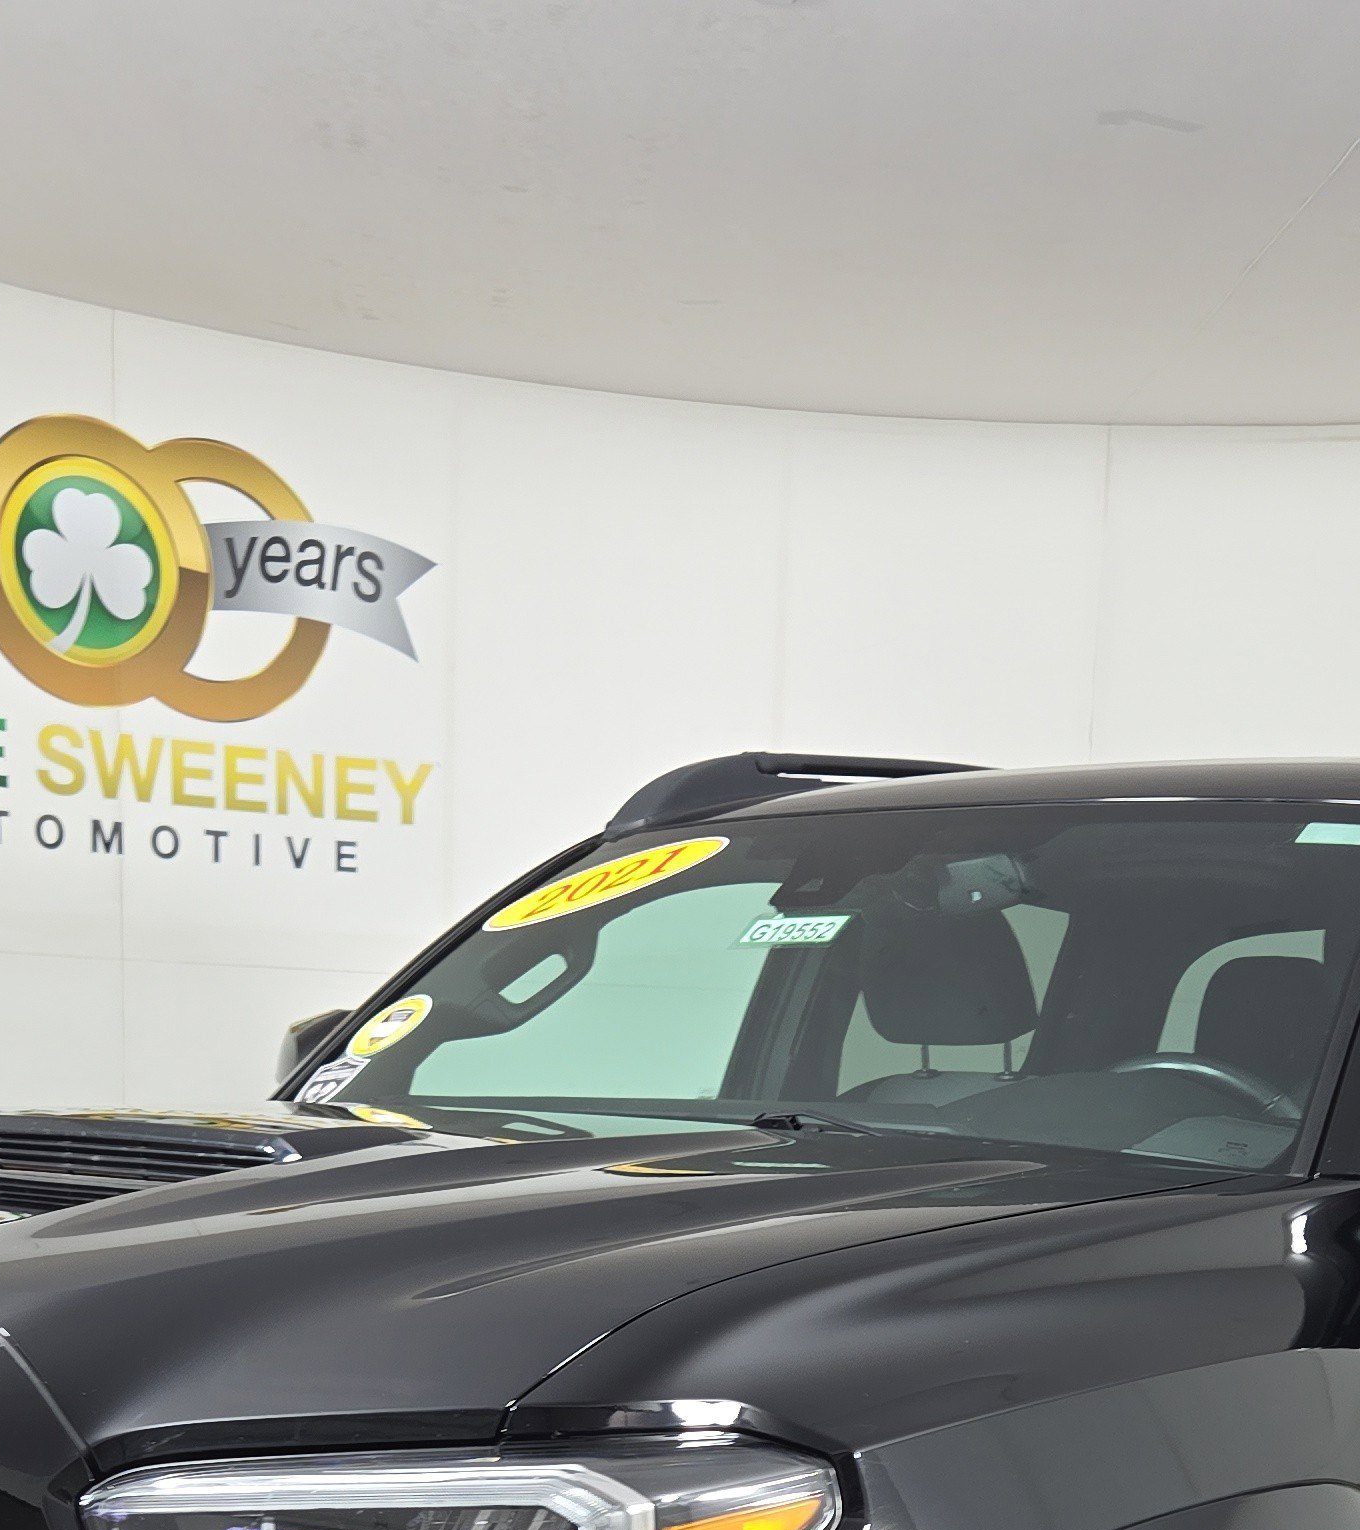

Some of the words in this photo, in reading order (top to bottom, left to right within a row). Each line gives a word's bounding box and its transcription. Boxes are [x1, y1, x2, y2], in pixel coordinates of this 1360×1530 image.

[223, 534, 385, 603] years
[36, 723, 435, 826] SWEENEY
[520, 845, 689, 921] 2021
[749, 921, 836, 942] G19552
